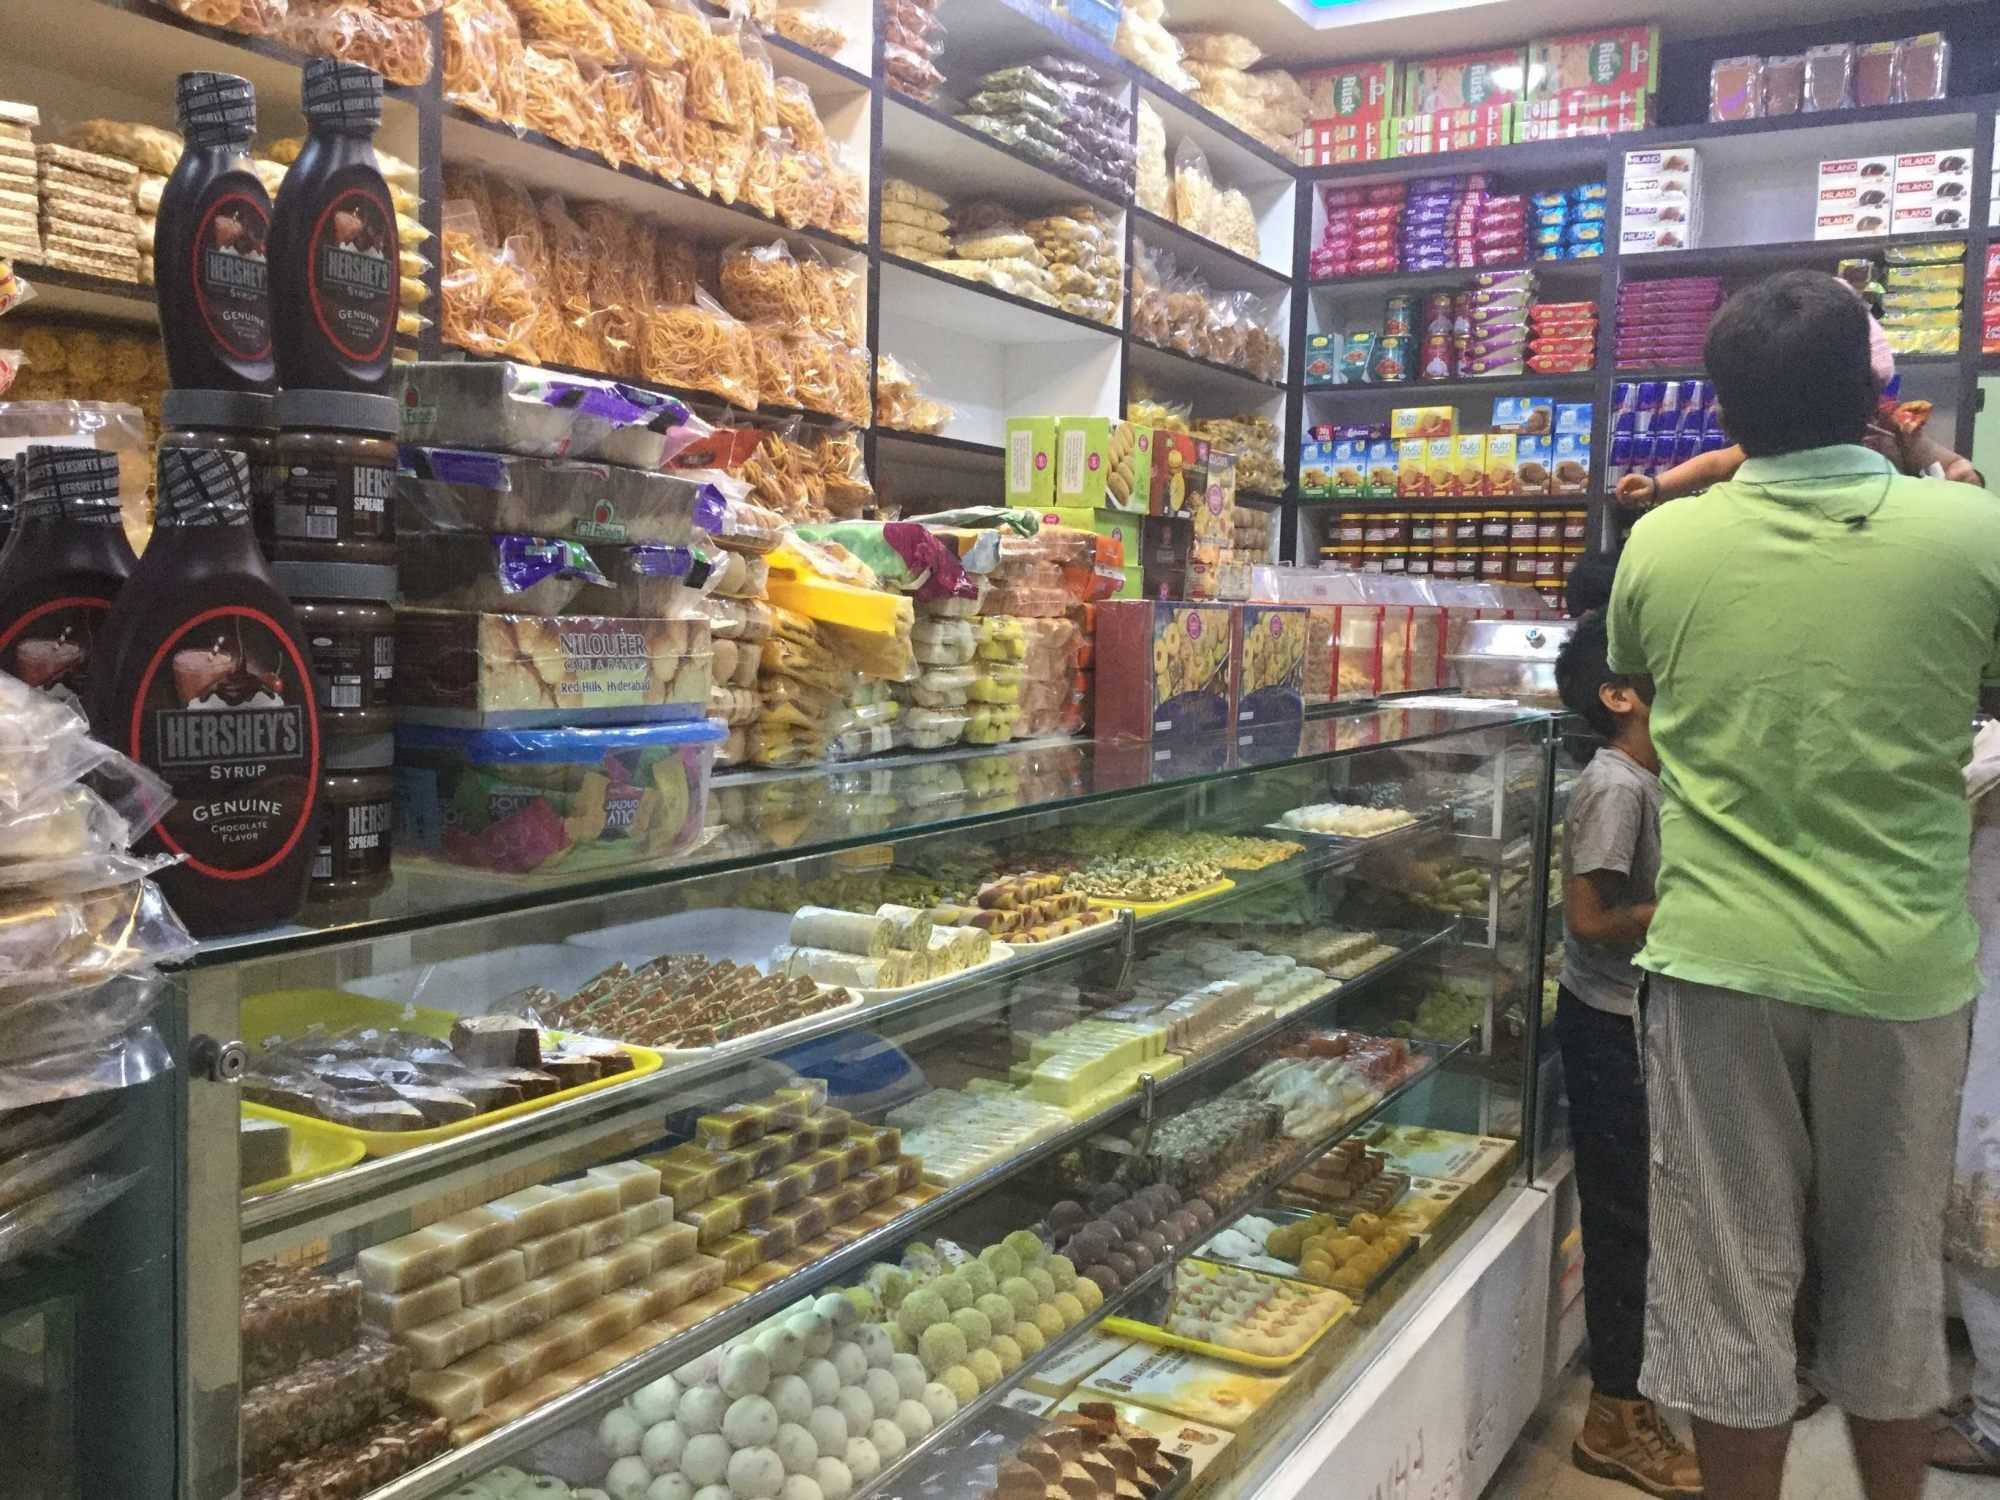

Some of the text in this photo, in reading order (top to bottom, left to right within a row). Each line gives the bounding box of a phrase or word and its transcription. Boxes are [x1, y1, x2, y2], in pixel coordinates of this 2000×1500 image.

[1597, 41, 1616, 82] Rusk
[1470, 63, 1486, 103] Rusk
[1340, 75, 1356, 115] Rusk
[1823, 162, 1857, 174] MILANO
[1900, 155, 1935, 168] MILANO
[1821, 189, 1856, 200] MILANO
[1897, 182, 1933, 193] MILANO
[1819, 215, 1853, 226] MILANO
[1896, 208, 1932, 219] MILANO
[328, 251, 388, 290] HERSHEY'S
[222, 311, 265, 328] GENUINE
[338, 309, 380, 327] GENUINE
[353, 466, 395, 497] HERS
[560, 633, 647, 657] NILOUFER
[561, 681, 579, 693] Red
[607, 679, 650, 693] Hyderabad
[166, 711, 297, 758] HERSHEY'S
[209, 764, 267, 780] SYRUP
[192, 799, 283, 822] GENUINE
[348, 801, 392, 835] HERS
[210, 820, 269, 834] CHOCOLATE
[222, 832, 259, 843] FLAVOR
